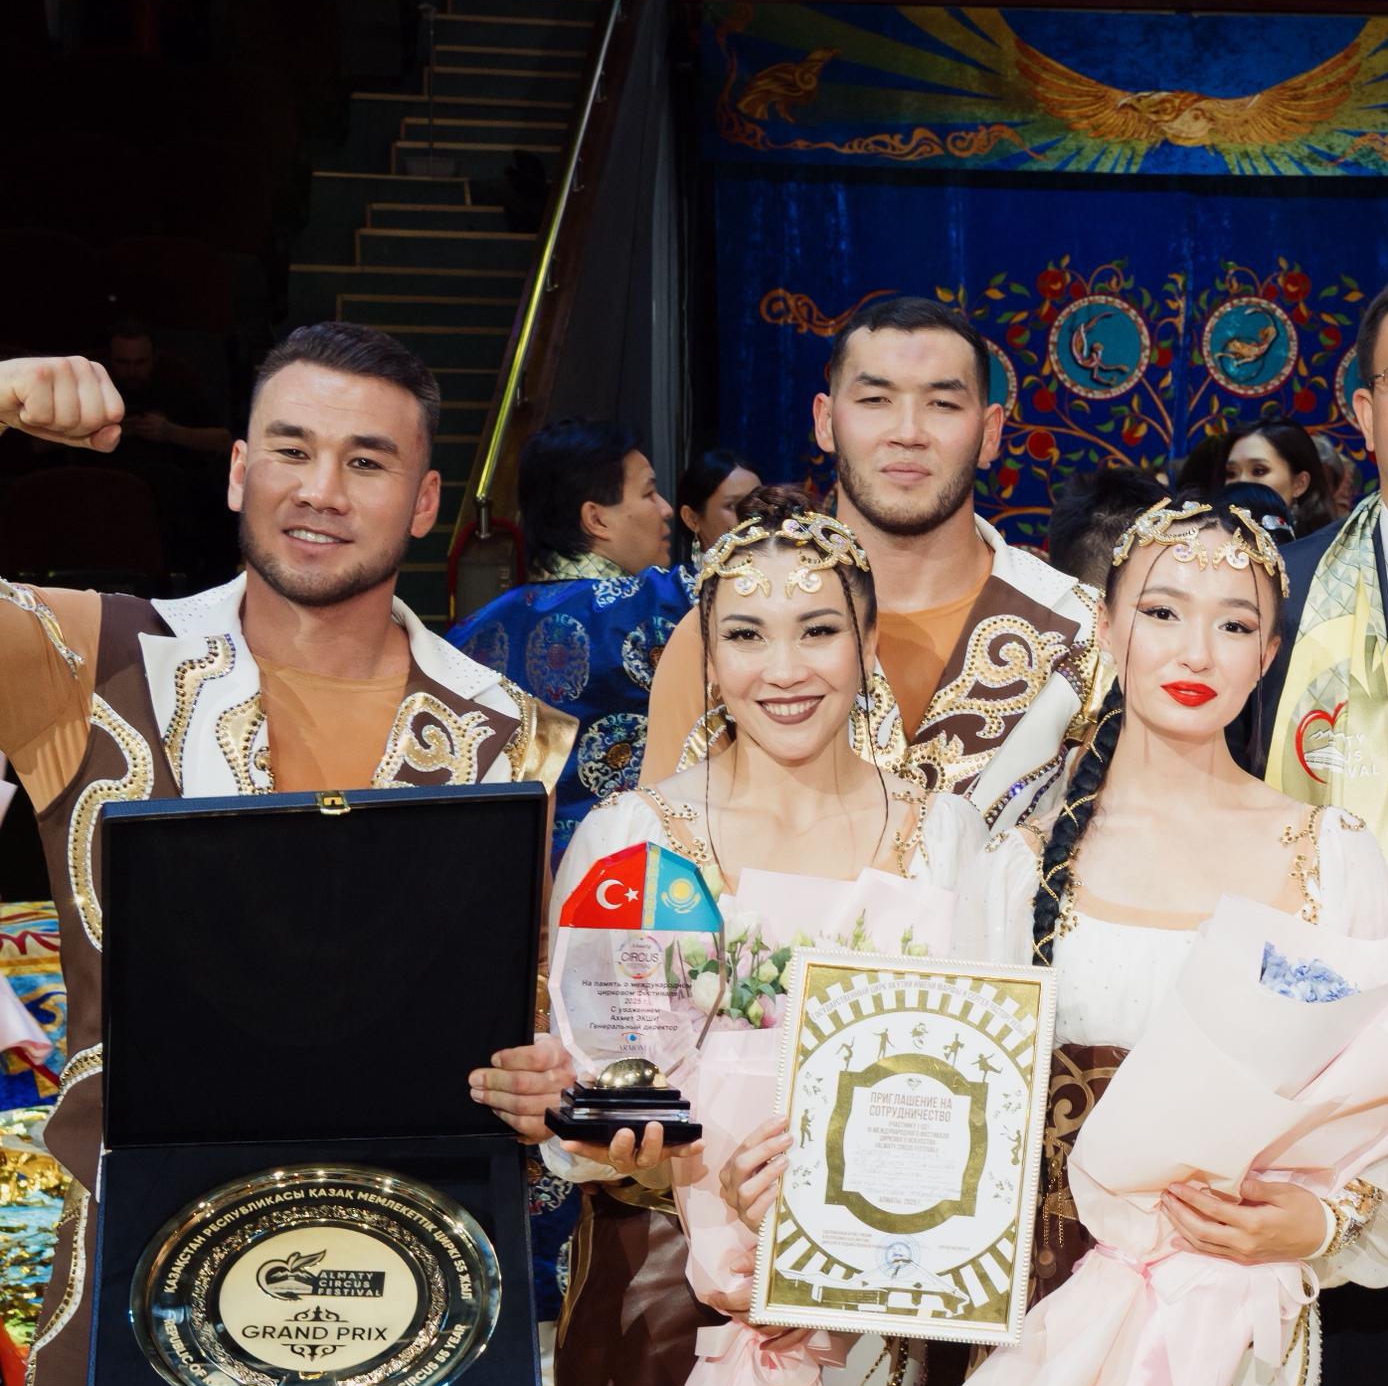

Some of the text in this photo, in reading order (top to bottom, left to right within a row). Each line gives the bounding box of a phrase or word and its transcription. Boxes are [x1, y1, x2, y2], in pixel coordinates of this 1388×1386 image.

[870, 1092, 938, 1108] ПРИГЛАШЕНИЕ
[869, 1105, 951, 1122] СОТРУДНИЧЕСТВО
[203, 1188, 305, 1237] РЕСПУБЛИКАСЫ
[454, 1260, 467, 1273] 55
[320, 1271, 373, 1280] ALMATY
[317, 1288, 381, 1296] FESTIVAL
[319, 1280, 370, 1288] CIRCUS
[460, 1272, 473, 1300] ЖЫЛ
[242, 1325, 388, 1341] GRAND PRIX
[434, 1349, 451, 1365] 55
[448, 1323, 470, 1350] YEAR
